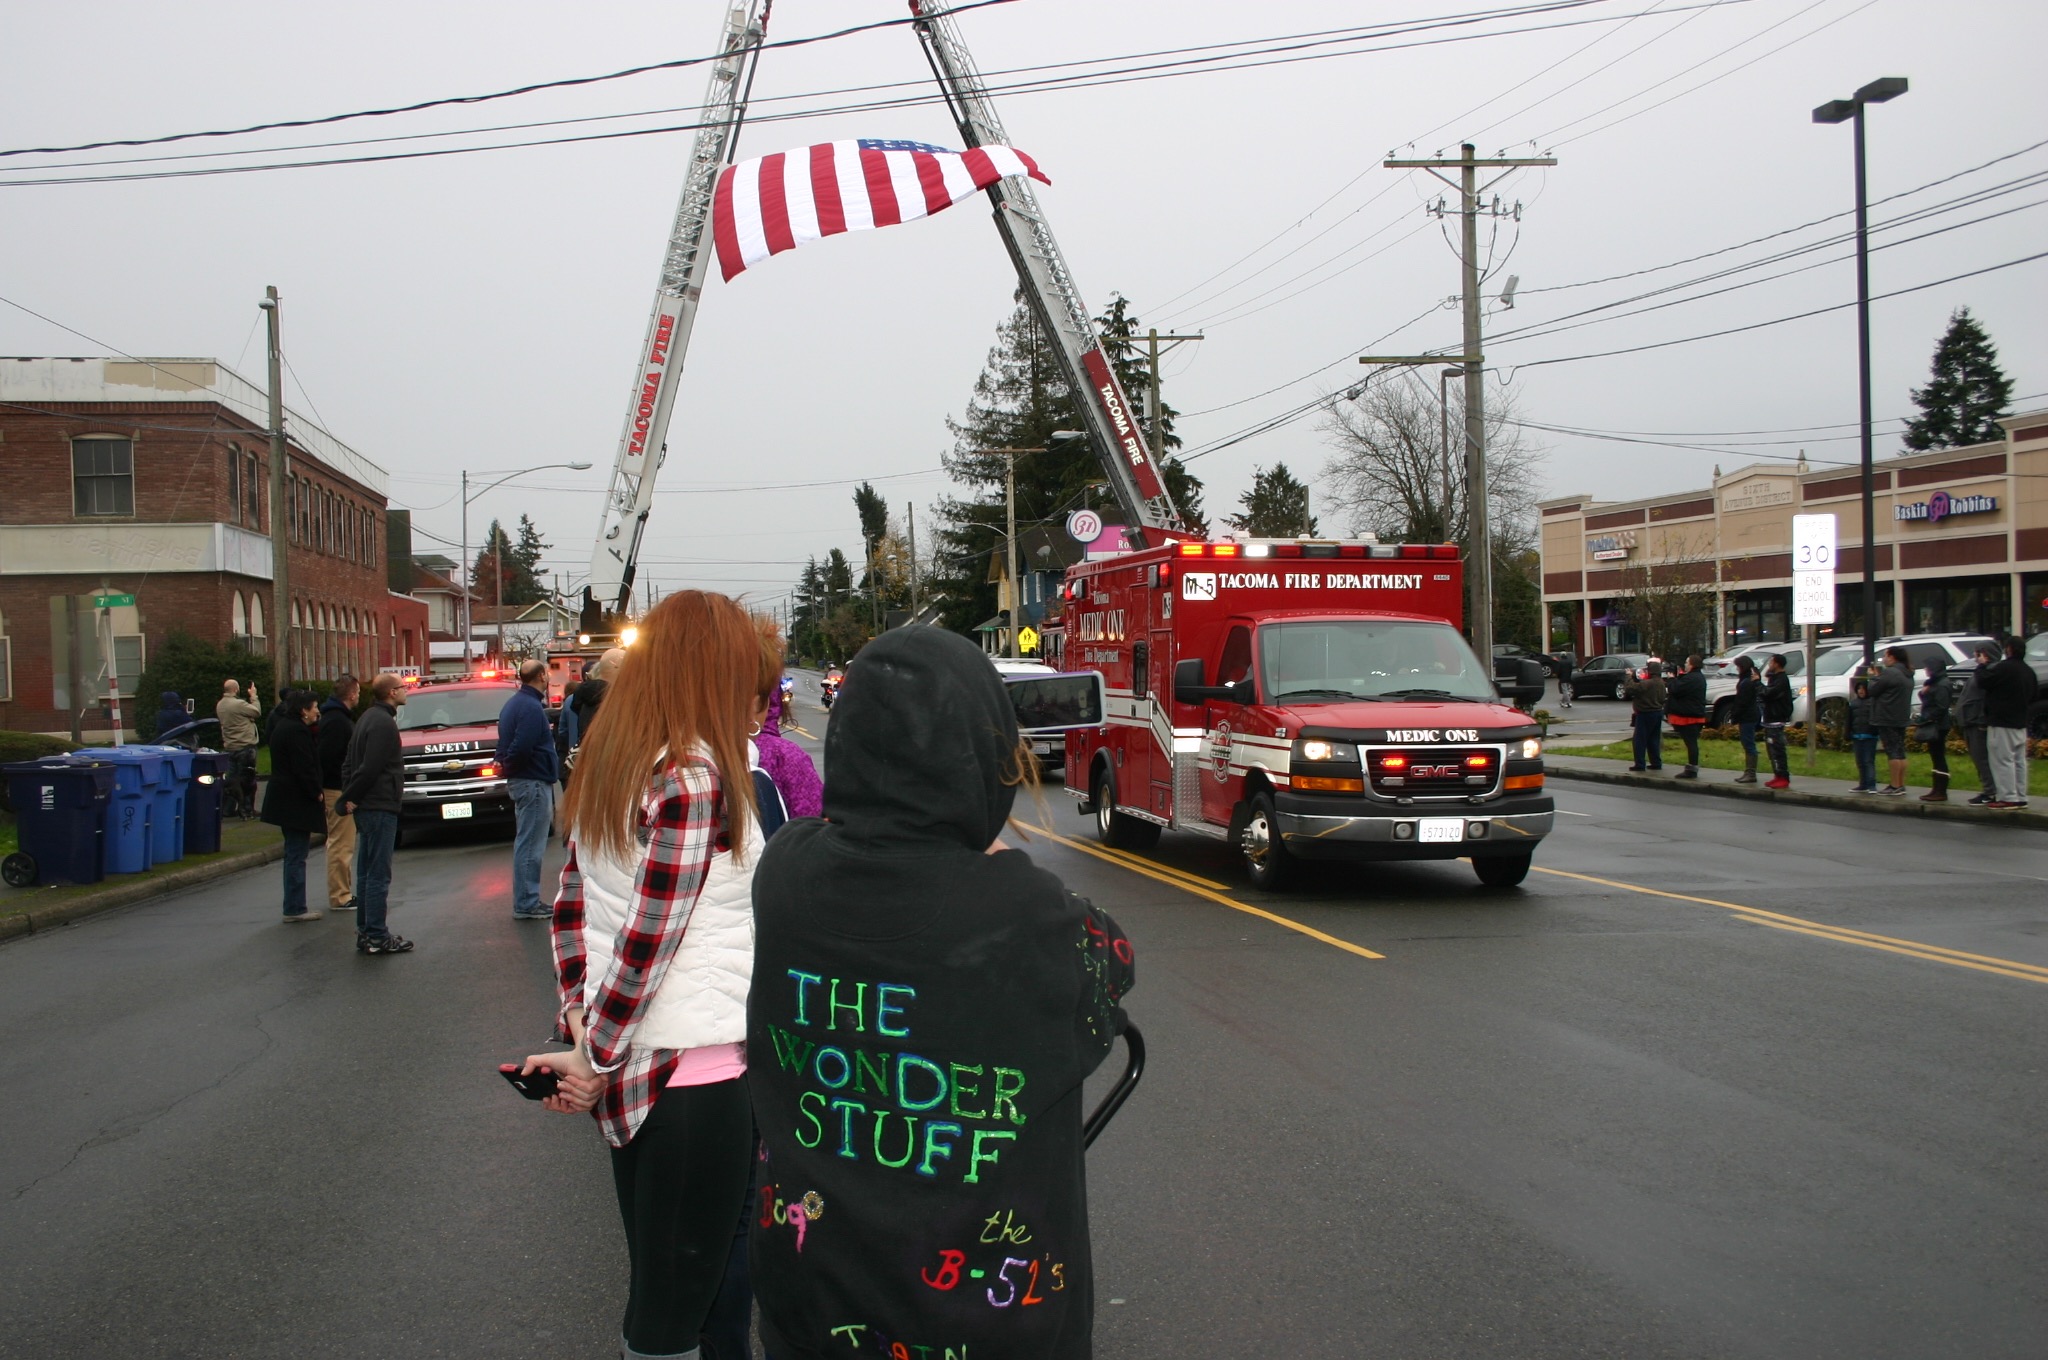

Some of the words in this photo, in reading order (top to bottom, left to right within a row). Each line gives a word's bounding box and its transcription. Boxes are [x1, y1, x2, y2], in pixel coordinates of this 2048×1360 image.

[628, 371, 661, 456] TACOMA
[651, 313, 675, 366] FIRE
[1101, 383, 1130, 436] TACOMA
[1124, 437, 1144, 466] FIRE
[1895, 503, 1928, 520] Baskin
[1949, 496, 1992, 514] Robbins
[1073, 516, 1096, 535] 31
[1799, 545, 1829, 563] 30
[1186, 577, 1214, 596] M-5
[1219, 573, 1279, 589] TACOMA
[1285, 574, 1320, 589] FIRE
[1327, 574, 1423, 589] DEPARTMENT
[1805, 576, 1822, 586] END
[1797, 592, 1830, 602] SCHOOL
[1802, 607, 1825, 617] ZONE
[1079, 611, 1105, 641] MEDIC
[1107, 608, 1125, 641] ONE
[424, 742, 469, 753] SAFETY
[474, 741, 480, 750] 1
[1386, 730, 1440, 742] MEDIC
[1445, 729, 1479, 741] ONE
[1411, 765, 1459, 777] GMC
[787, 968, 916, 1037] THE
[767, 1024, 1027, 1125] WONDER
[795, 1091, 1017, 1184] STUFF
[979, 1209, 1032, 1244] the
[921, 1249, 1065, 1307] B-52's
